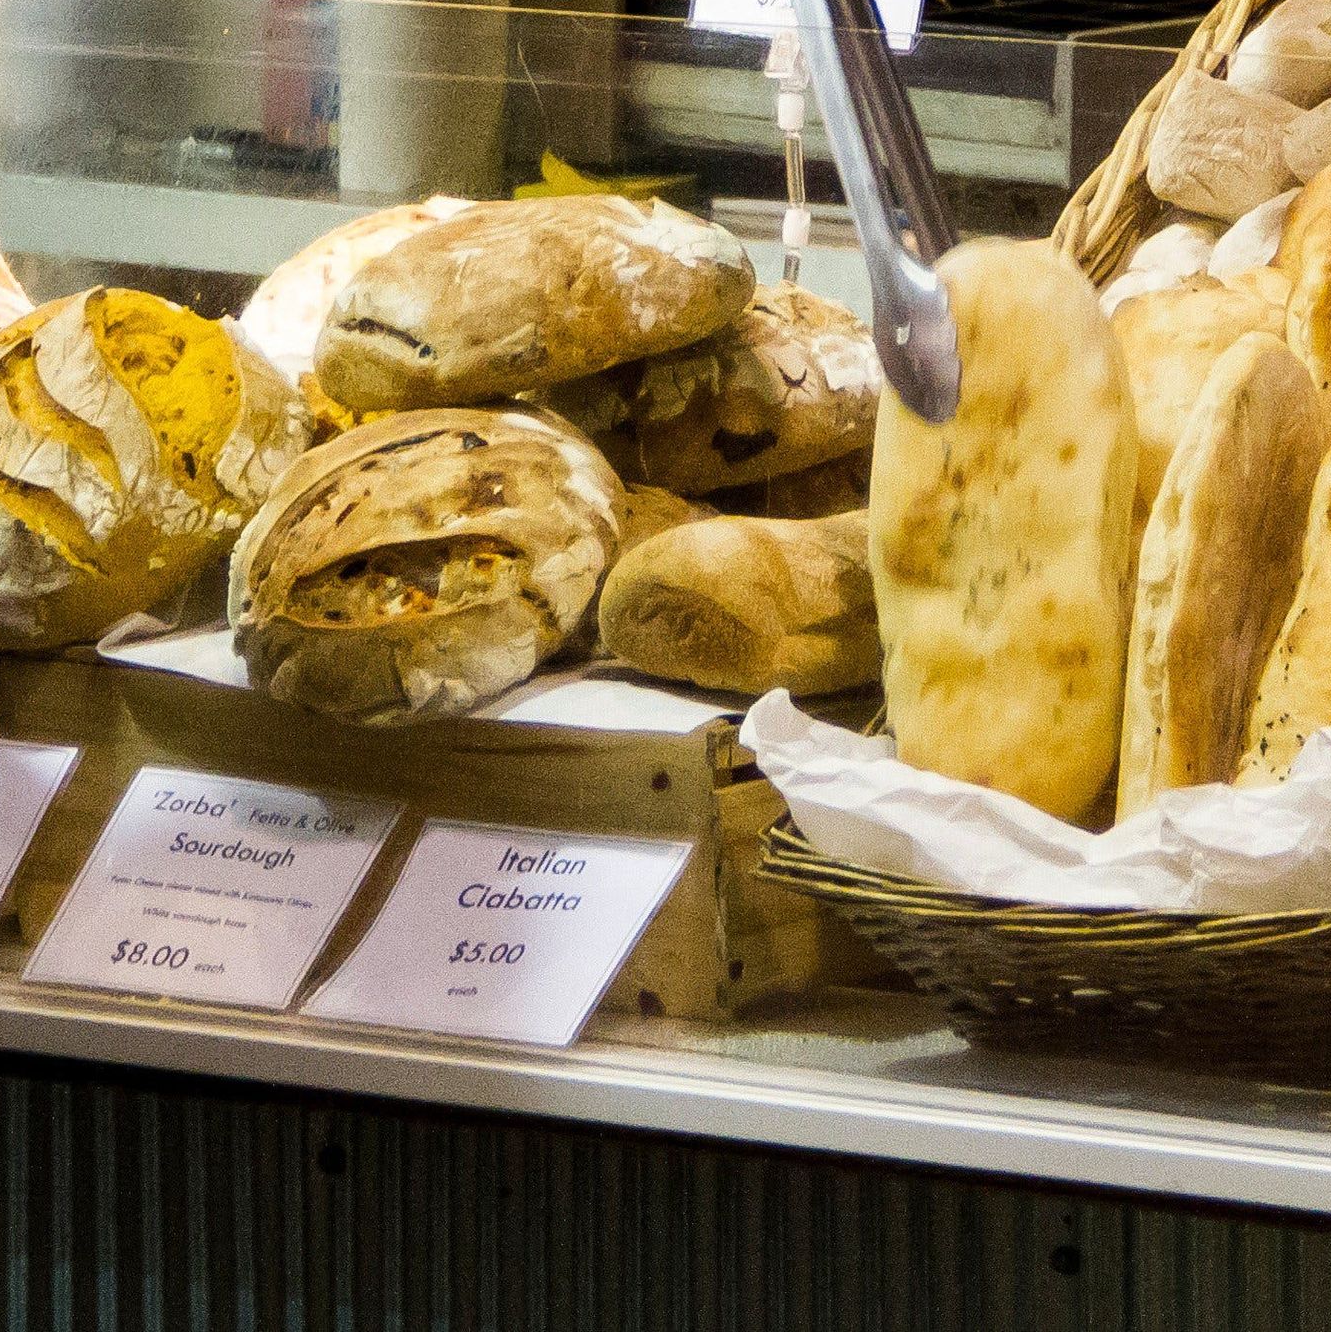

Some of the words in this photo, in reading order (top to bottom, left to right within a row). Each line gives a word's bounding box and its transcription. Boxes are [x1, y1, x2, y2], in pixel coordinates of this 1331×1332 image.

[153, 790, 239, 819] 'Zorba'
[248, 808, 291, 828] Fetta
[294, 812, 309, 829] &
[313, 816, 356, 835] Olive
[169, 831, 297, 870] Sourdough
[497, 846, 587, 875] Italian
[457, 883, 583, 911] Ciabatta
[110, 938, 191, 970] $8.00
[193, 961, 226, 975] each
[448, 939, 527, 964] $5.00
[447, 985, 479, 997] each
